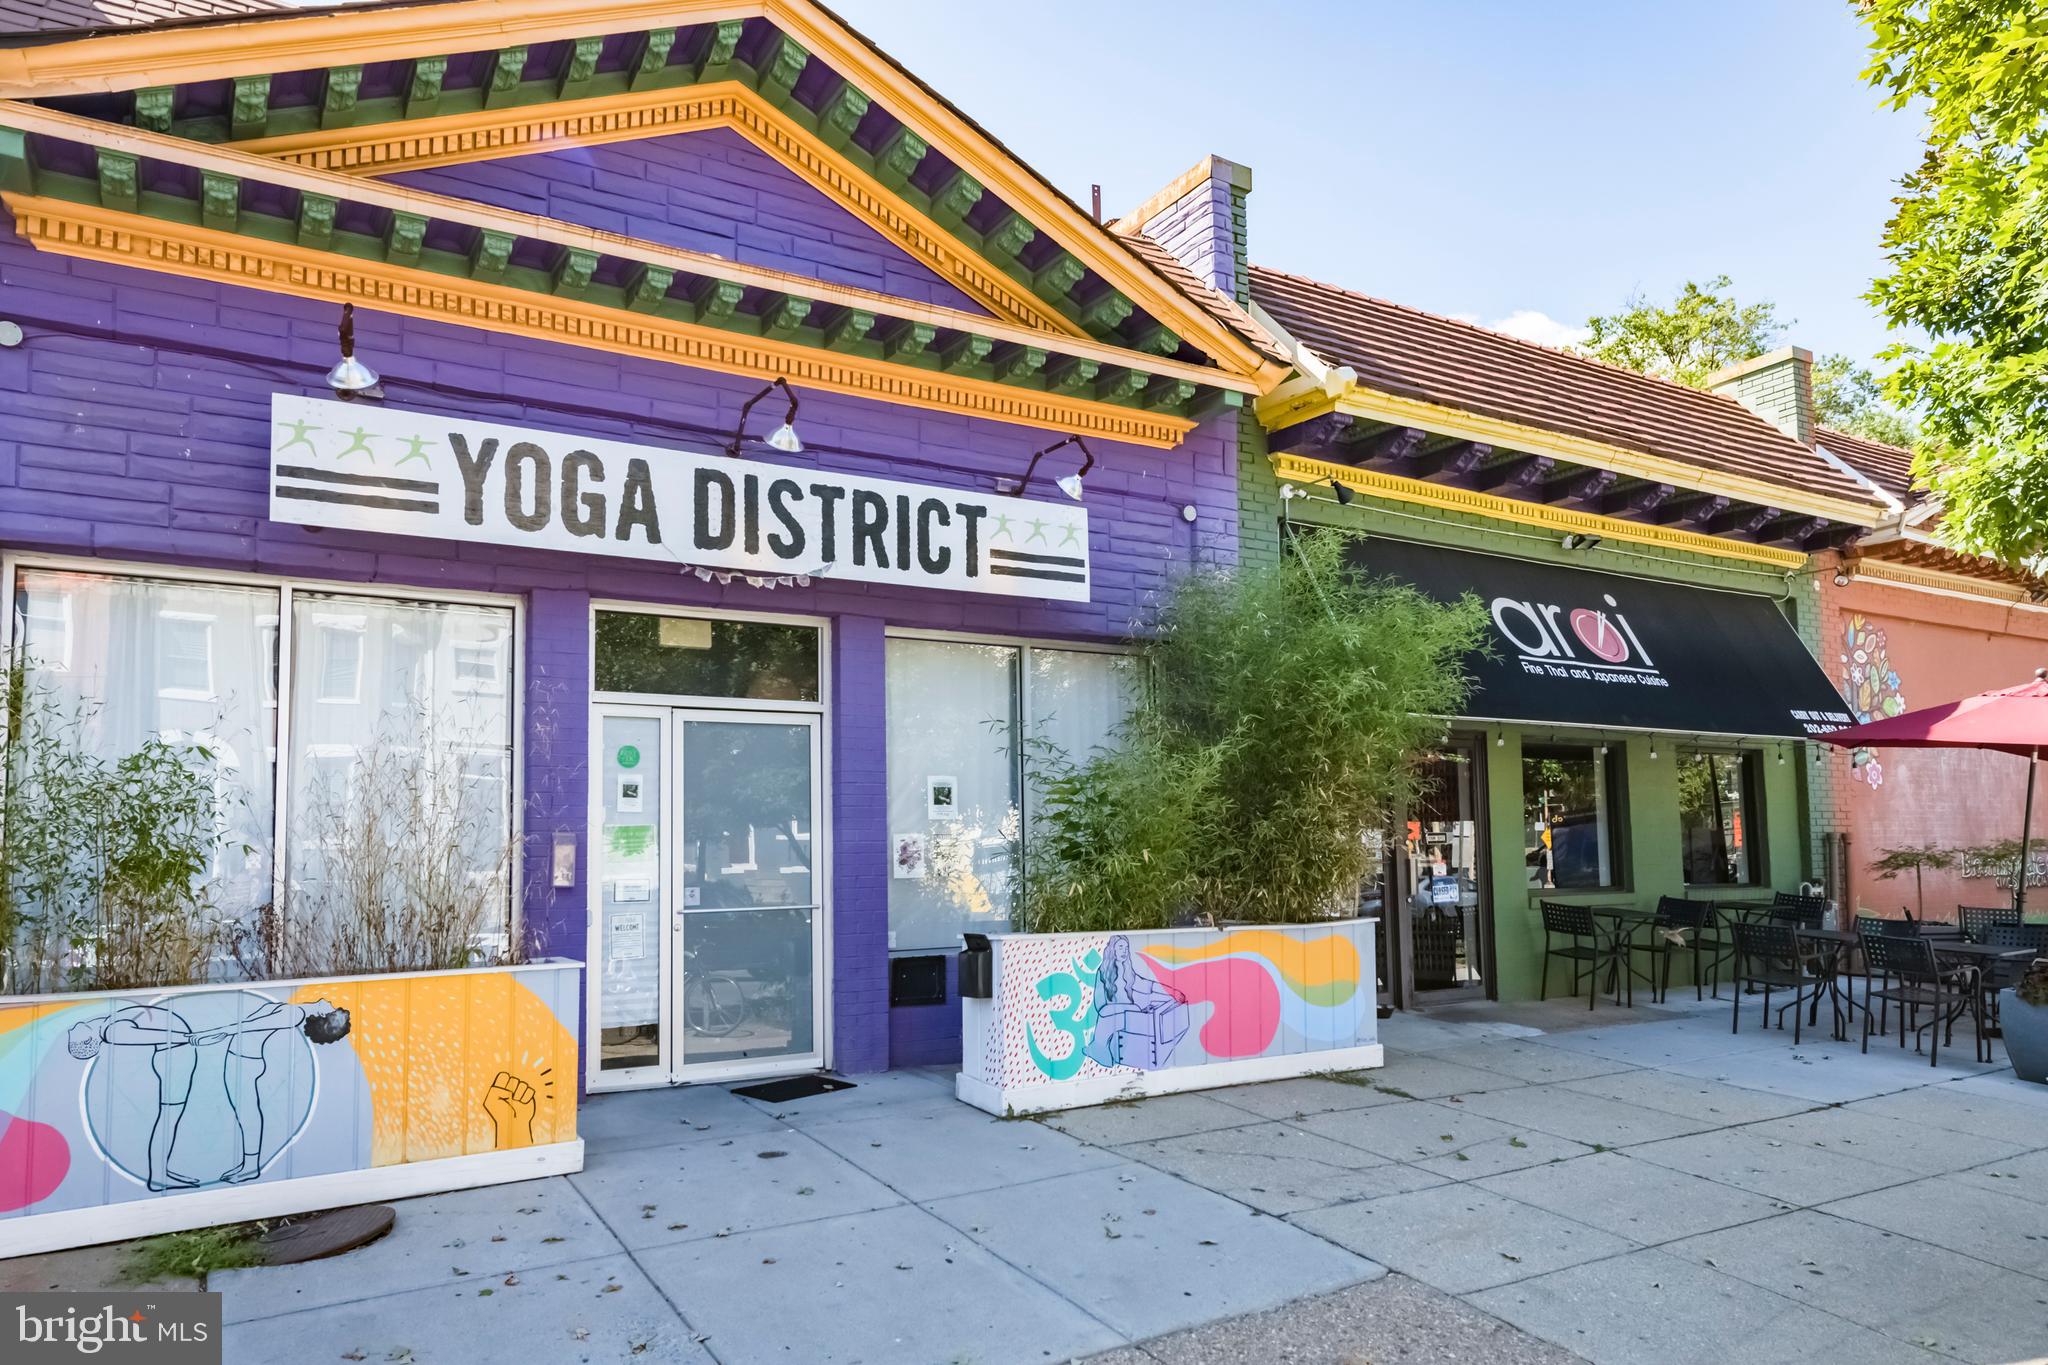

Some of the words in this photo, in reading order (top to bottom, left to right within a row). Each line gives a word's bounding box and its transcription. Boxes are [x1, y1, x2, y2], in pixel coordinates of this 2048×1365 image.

[447, 432, 661, 545] YOGA
[693, 467, 988, 577] DISTRICT
[1491, 593, 1654, 666] aroi
[1521, 661, 1545, 675] Fine
[1545, 664, 1569, 677] Thai
[1571, 668, 1592, 680] and
[1594, 671, 1636, 684] Japanese
[1637, 674, 1670, 688] Cuisine
